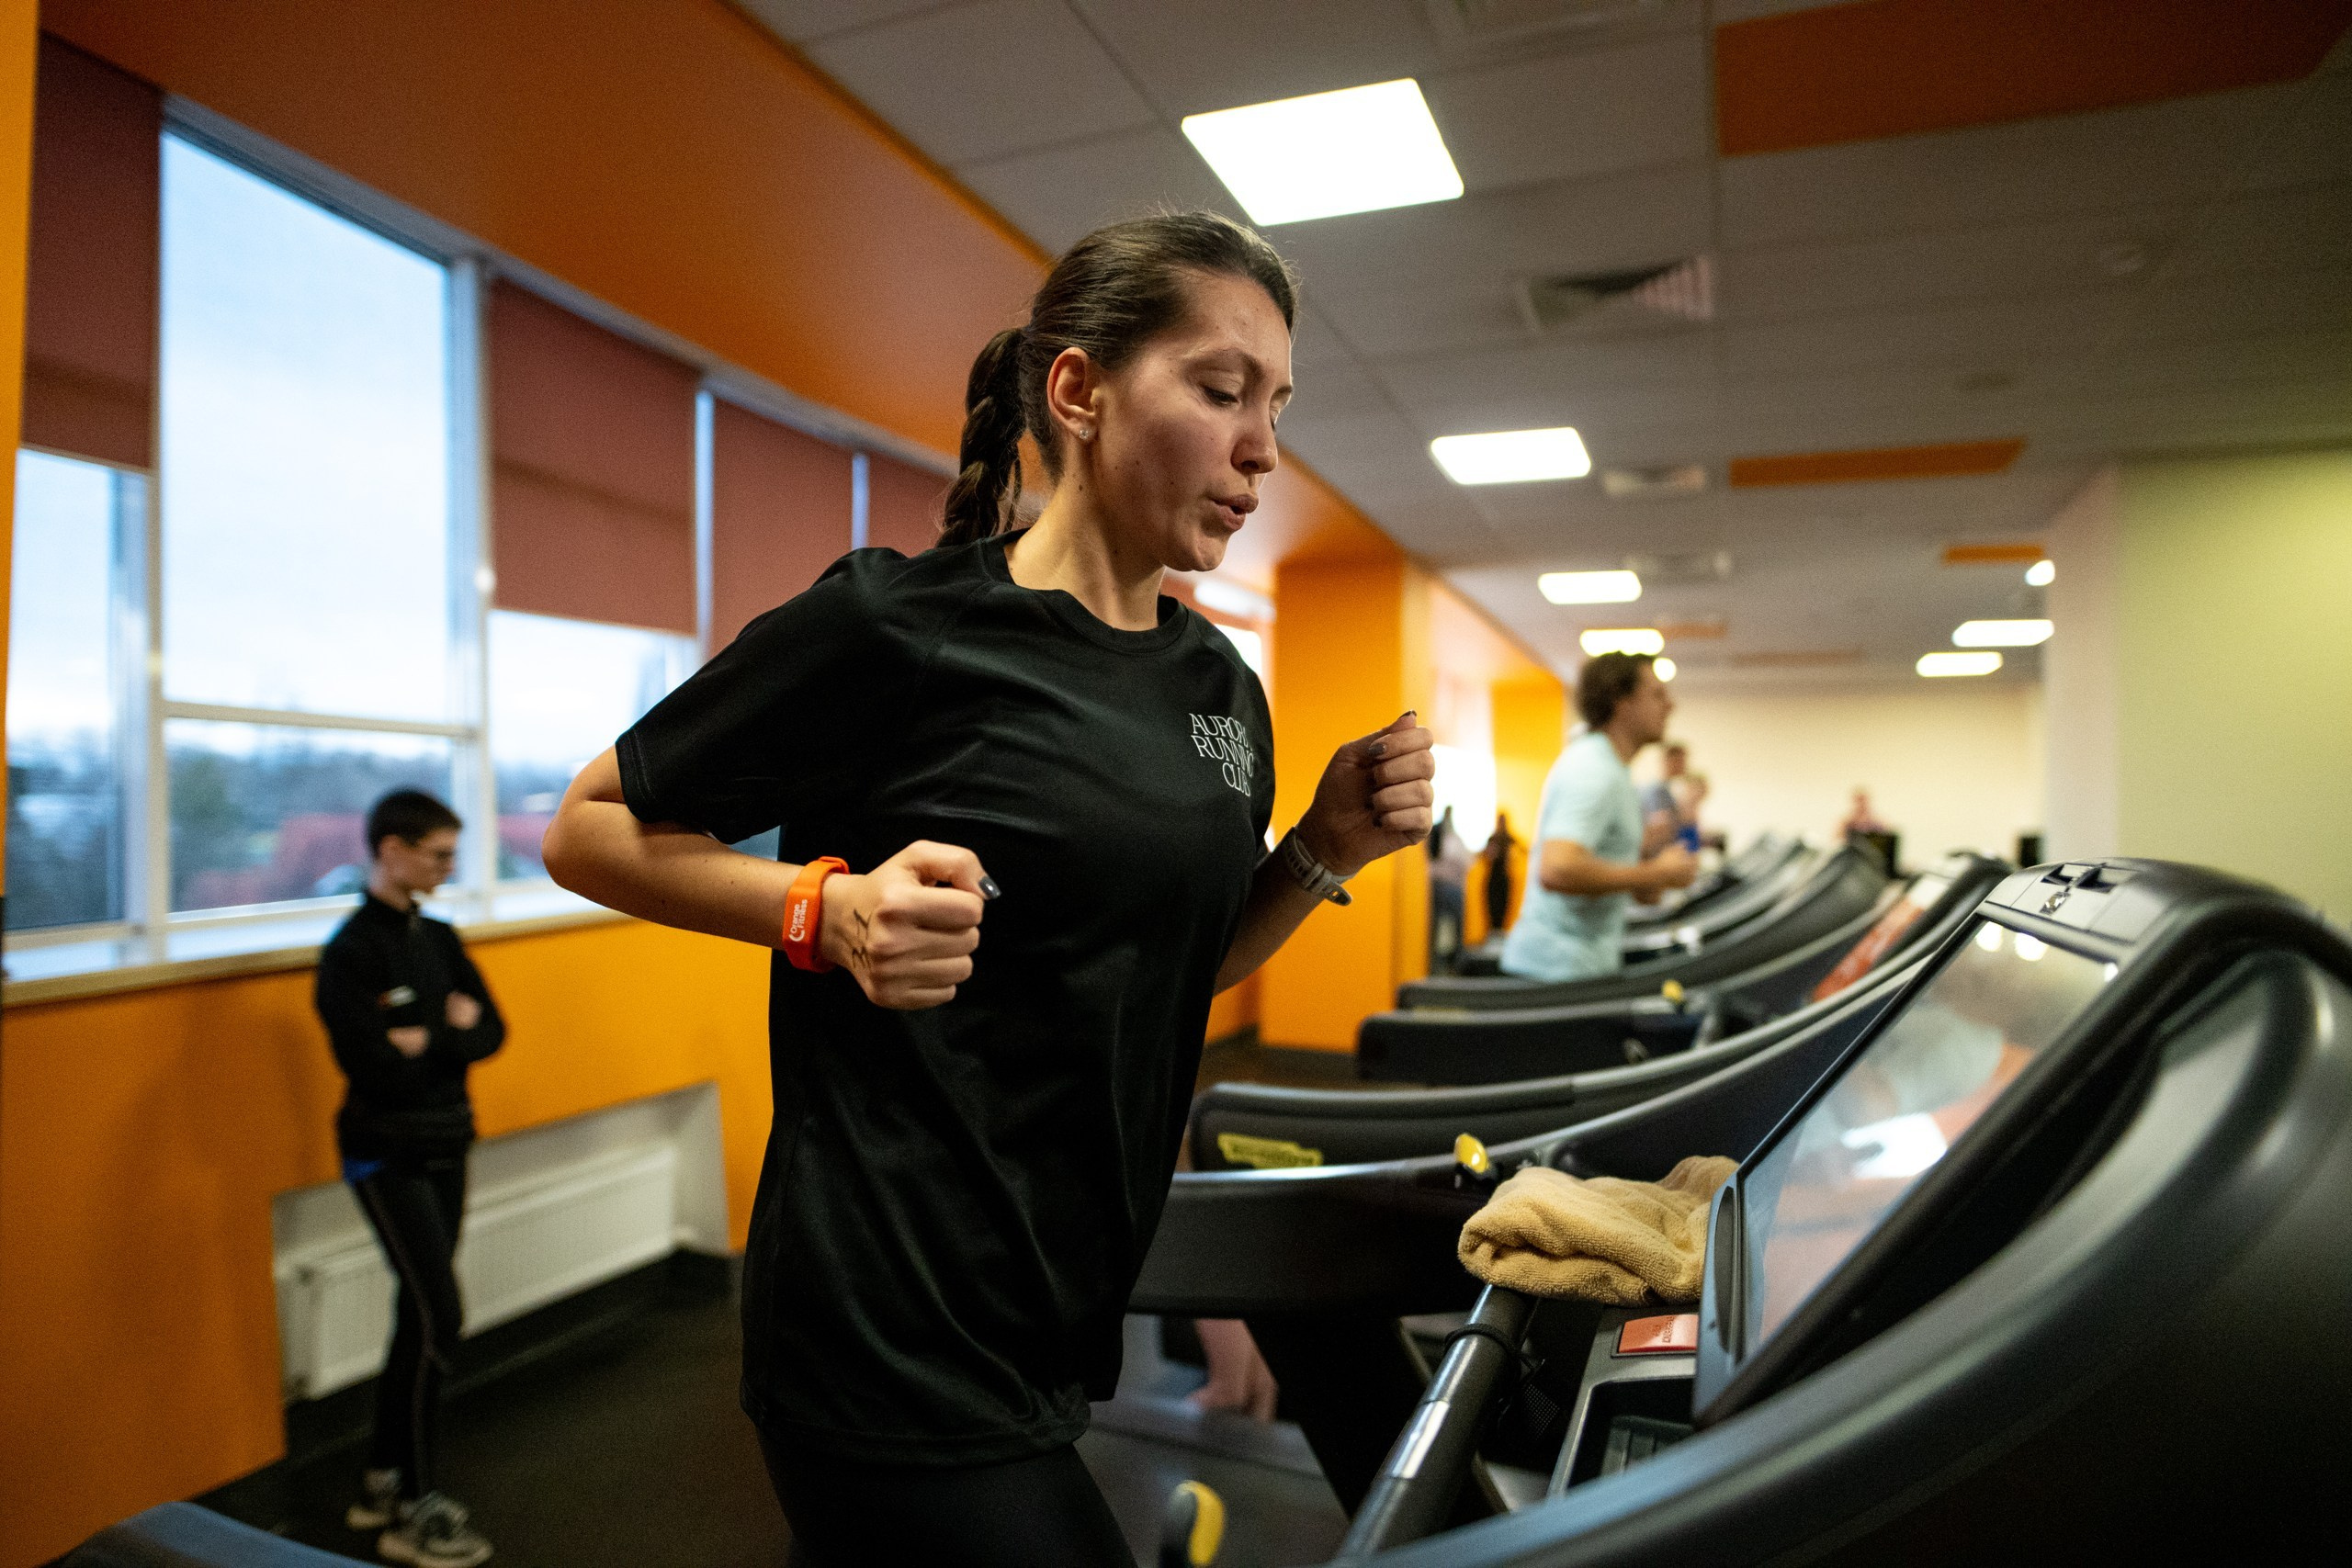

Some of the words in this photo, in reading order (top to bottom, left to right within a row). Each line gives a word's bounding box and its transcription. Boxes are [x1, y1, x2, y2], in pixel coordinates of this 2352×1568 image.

[1222, 762, 1251, 796] CLUB
[790, 904, 800, 933] Orange
[797, 899, 808, 929] Fitness
